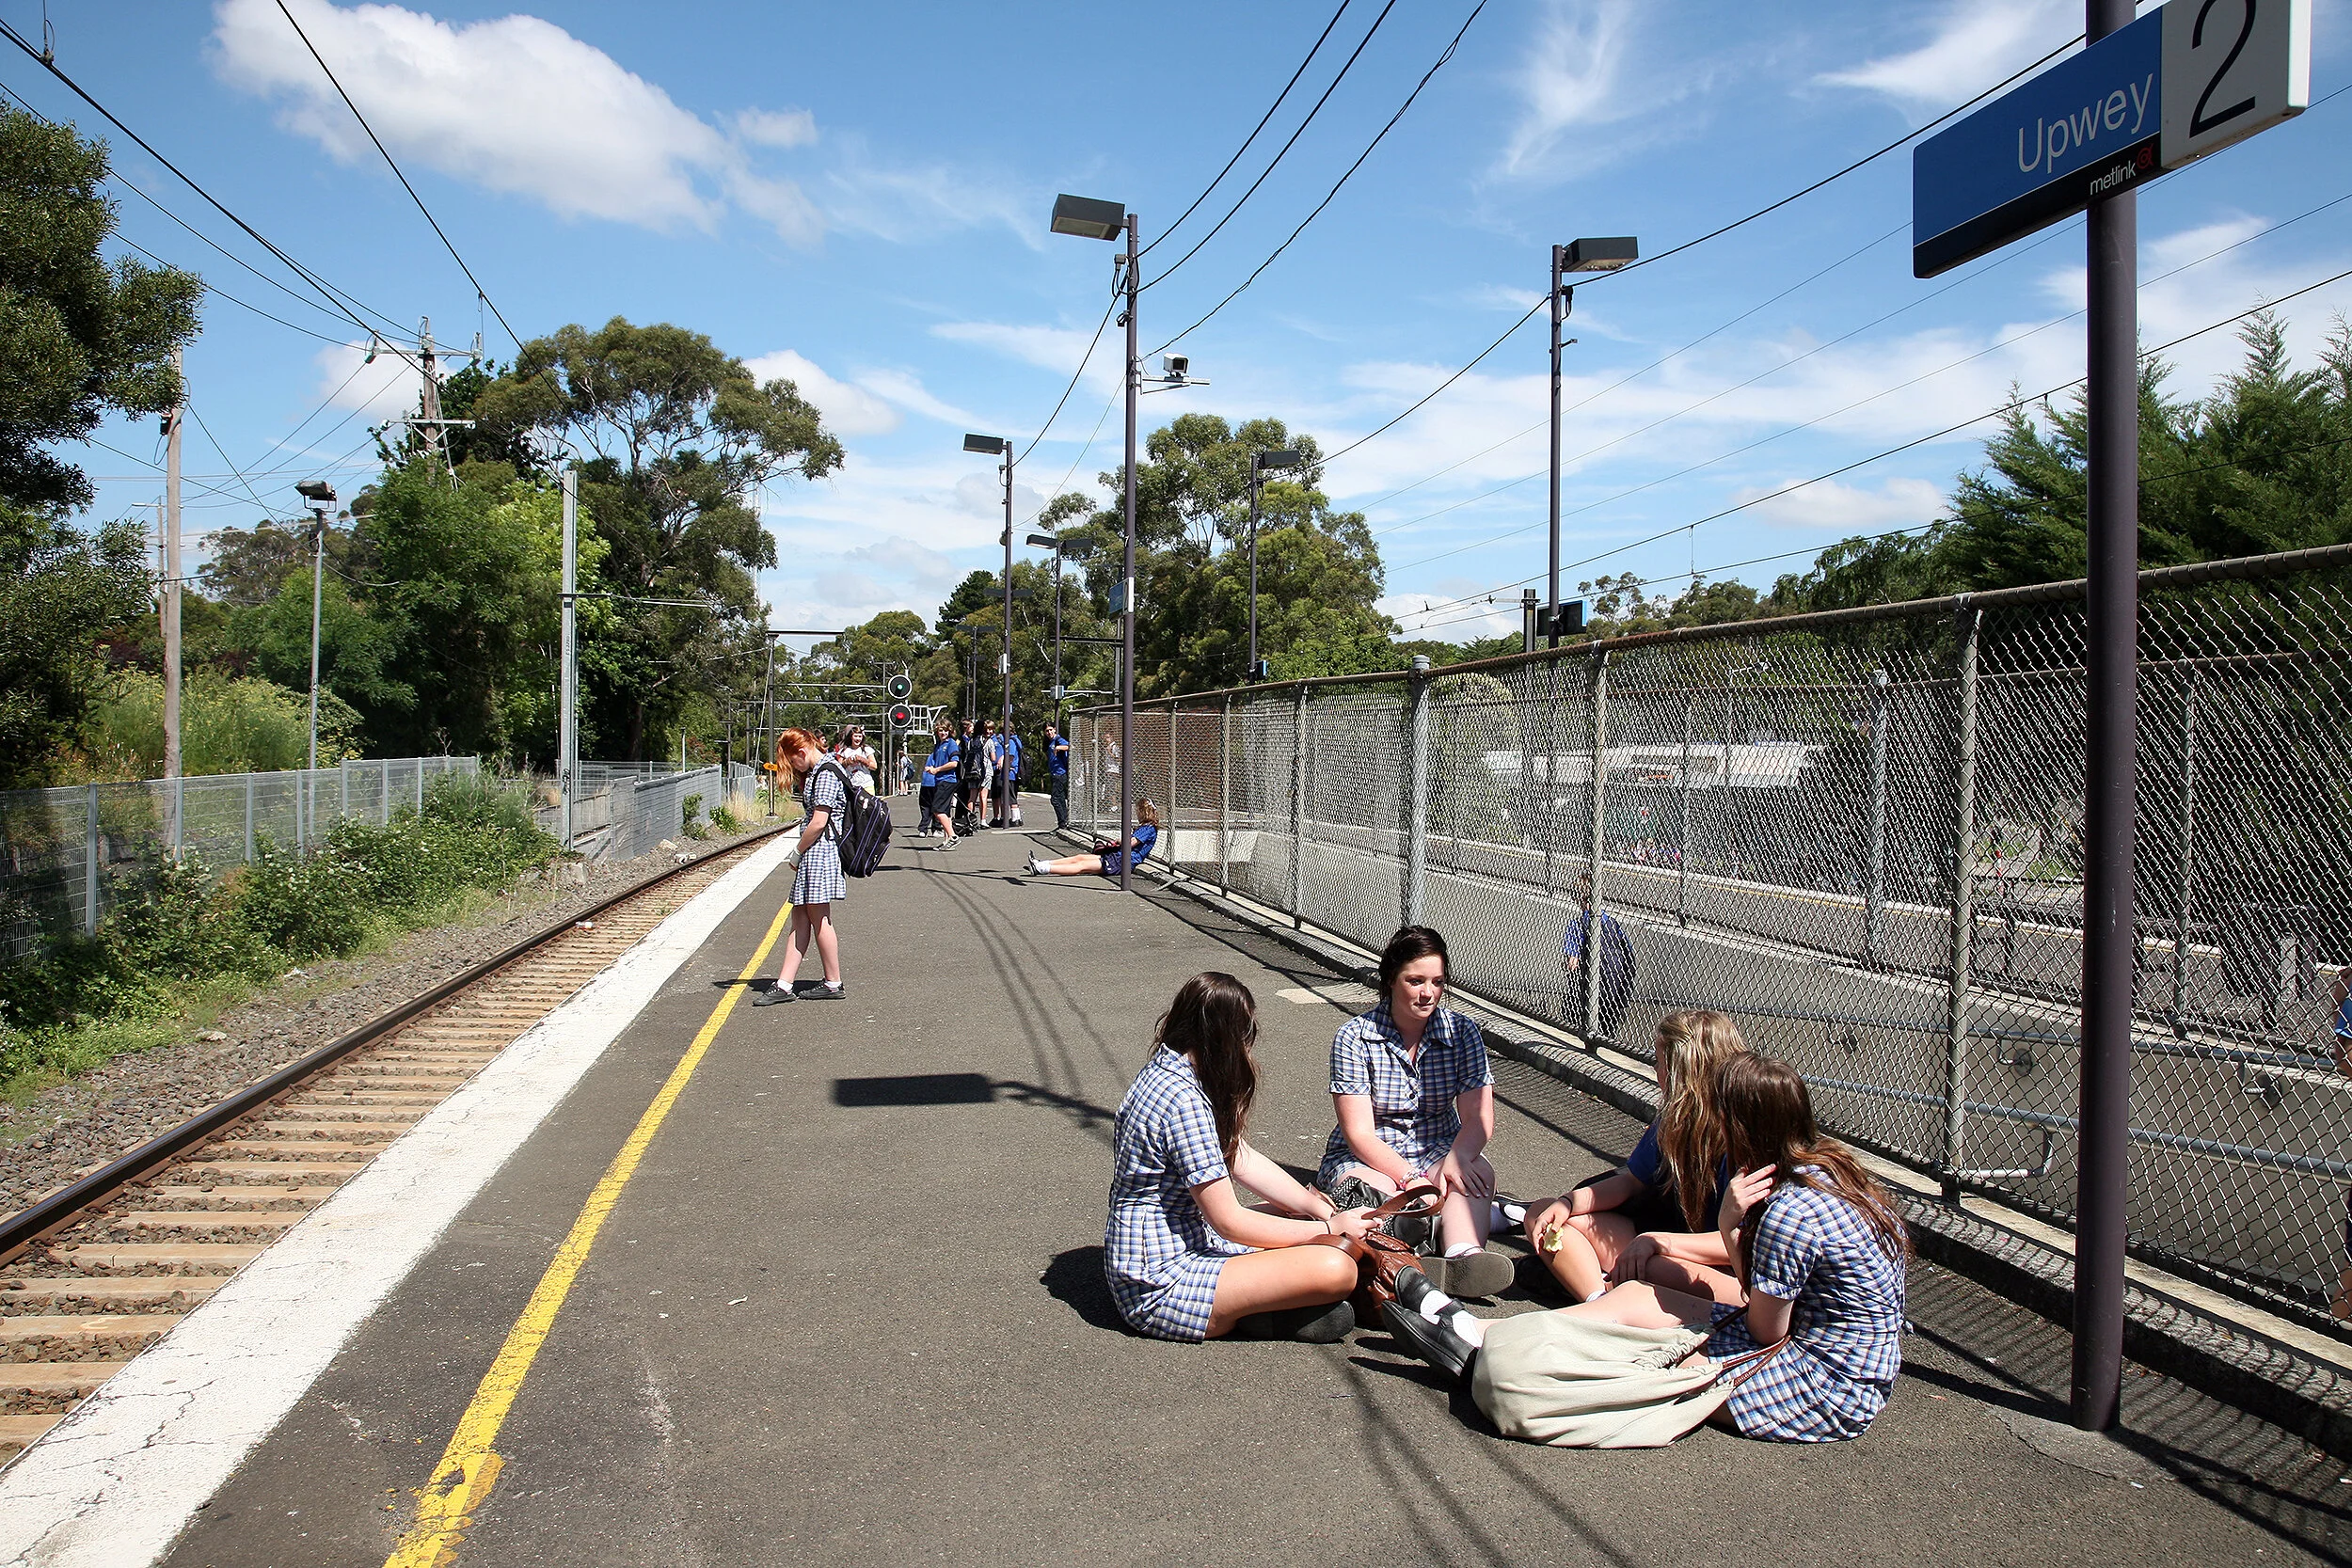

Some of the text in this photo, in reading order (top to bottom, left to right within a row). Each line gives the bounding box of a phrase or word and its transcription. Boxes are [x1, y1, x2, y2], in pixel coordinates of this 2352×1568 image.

[2018, 0, 2256, 174] Upwey 2
[2090, 160, 2137, 196] metlink
